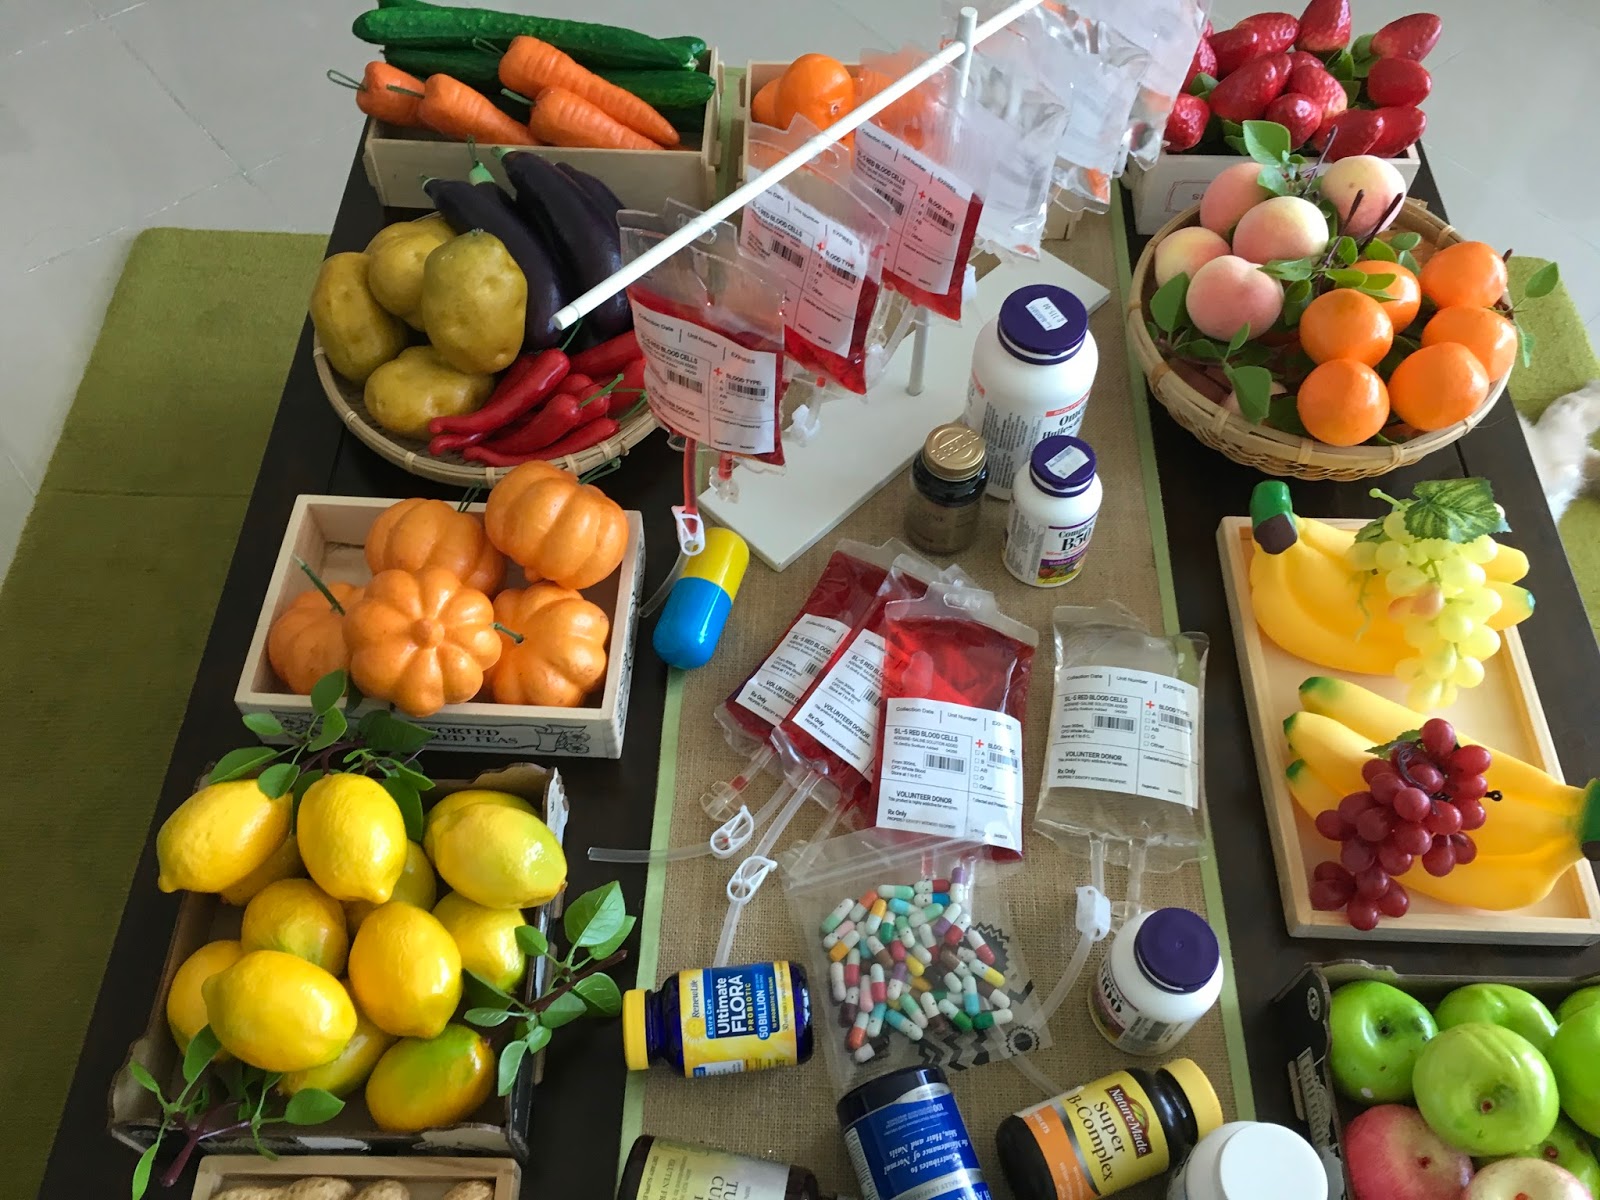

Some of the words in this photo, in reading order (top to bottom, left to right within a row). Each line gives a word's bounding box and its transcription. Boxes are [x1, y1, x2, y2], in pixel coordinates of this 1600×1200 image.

[875, 162, 891, 176] BLOOD
[891, 172, 905, 186] CELLS
[770, 215, 787, 228] BLOOD
[787, 224, 802, 237] CELLS
[661, 346, 680, 358] BLOOD
[680, 353, 698, 364] CELLS
[726, 373, 744, 383] BLOOD
[1061, 527, 1092, 551] B50
[804, 638, 814, 646] RED
[814, 642, 831, 656] BLOOD
[864, 662, 874, 671] RED
[766, 680, 794, 700] VOLUNTEER
[757, 695, 767, 704] Only
[1159, 704, 1176, 713] BLOOD
[815, 718, 824, 727] Only
[824, 703, 853, 726] VOLUNTEER
[852, 724, 870, 739] DONOR
[958, 714, 977, 722] Number
[475, 736, 518, 744] TEAS
[921, 731, 940, 739] BLOOD
[941, 734, 958, 742] CELLS
[1065, 751, 1100, 759] VOLUNTEER
[1101, 753, 1122, 761] DONOR
[897, 790, 931, 801] VOLUNTEER
[932, 796, 952, 805] DONOR
[895, 810, 907, 818] Only
[716, 978, 730, 1035] Ultimate
[728, 975, 747, 1033] FLORA
[745, 983, 754, 1032] PROBIOTIC
[756, 990, 768, 1026] BILLION
[759, 1026, 768, 1038] 50
[1094, 1101, 1125, 1153] Super
[910, 1139, 924, 1151] and
[926, 1133, 942, 1144] Hair
[1067, 1094, 1114, 1182] B-Complex
[889, 1144, 908, 1159] Nails
[922, 1140, 961, 1157] Maintenance
[913, 1150, 920, 1163] of
[884, 1156, 911, 1176] Normal
[910, 1166, 918, 1174] to
